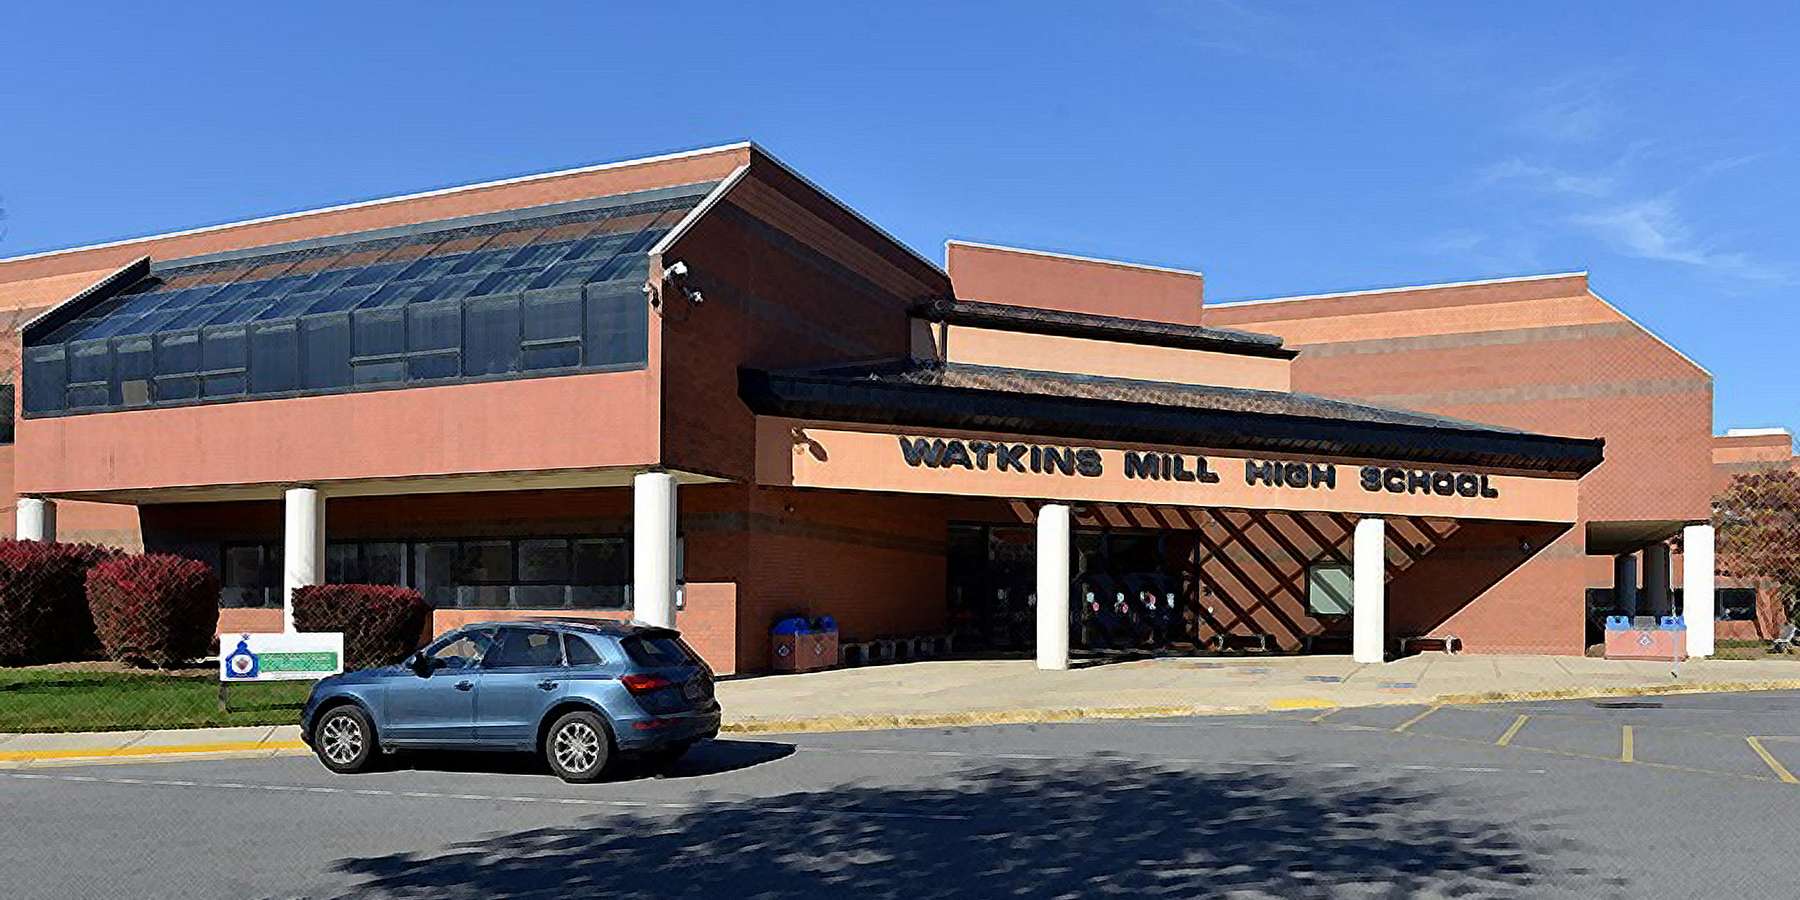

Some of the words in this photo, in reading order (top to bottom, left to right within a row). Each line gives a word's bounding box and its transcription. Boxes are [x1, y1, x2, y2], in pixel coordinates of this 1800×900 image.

[899, 437, 1103, 477] WATKINS
[1124, 452, 1220, 483] MILL
[1246, 460, 1336, 489] HIGH
[1360, 466, 1499, 498] SCHOOL
